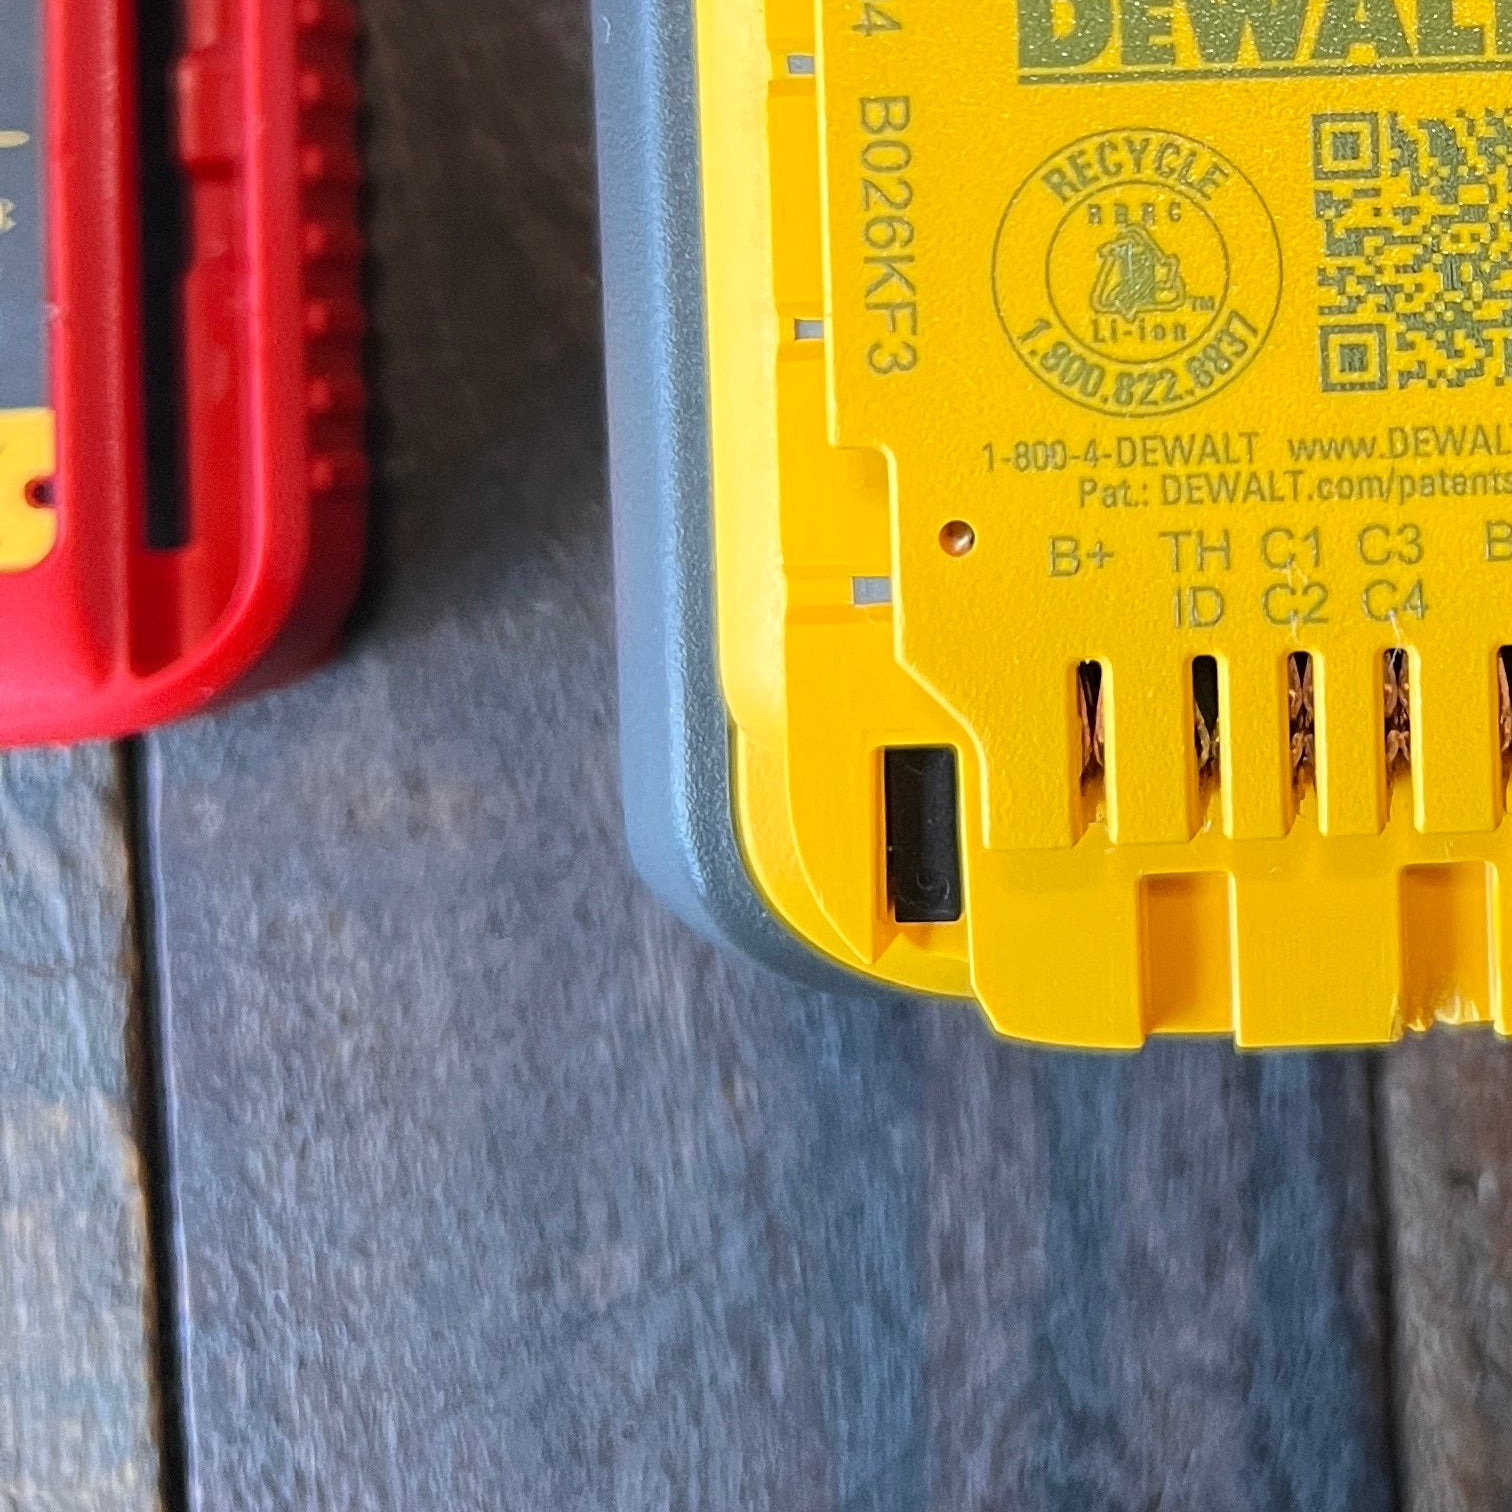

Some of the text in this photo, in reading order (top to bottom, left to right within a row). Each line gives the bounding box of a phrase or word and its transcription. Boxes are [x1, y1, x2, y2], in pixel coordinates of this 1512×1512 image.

[1040, 136, 1230, 205] RECYCLE
[858, 95, 918, 375] B026KF3
[981, 431, 1260, 473] 1-800-4-DEWALT
[1078, 475, 1149, 509] Pat.:
[1048, 535, 1115, 577] B+
[1158, 528, 1232, 572] TH
[1259, 525, 1322, 570] C1
[1356, 522, 1424, 566] C3
[1172, 578, 1429, 628] ID C2 C4
